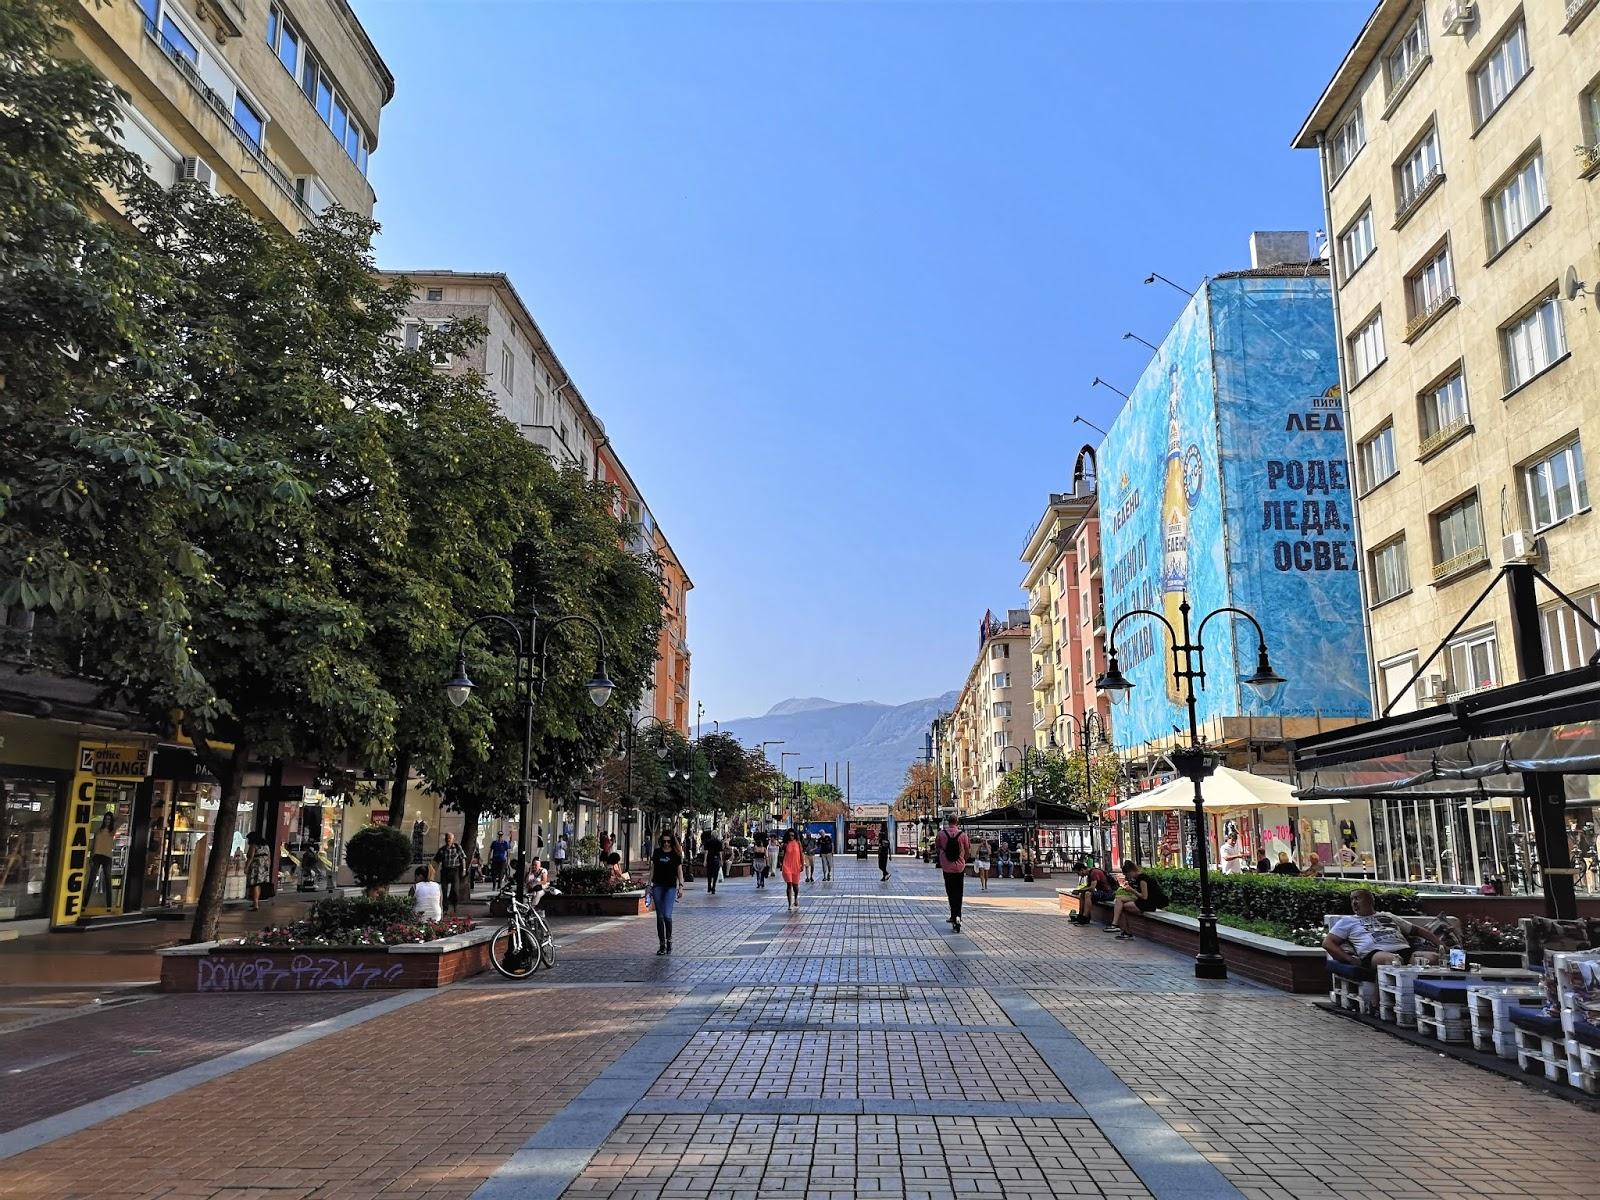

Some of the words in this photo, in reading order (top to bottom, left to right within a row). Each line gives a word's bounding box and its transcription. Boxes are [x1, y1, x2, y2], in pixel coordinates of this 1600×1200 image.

[1261, 500, 1350, 536] ЛЕДА,
[95, 749, 121, 760] Office
[95, 760, 147, 776] CHANGE
[65, 782, 94, 916] CHANGE
